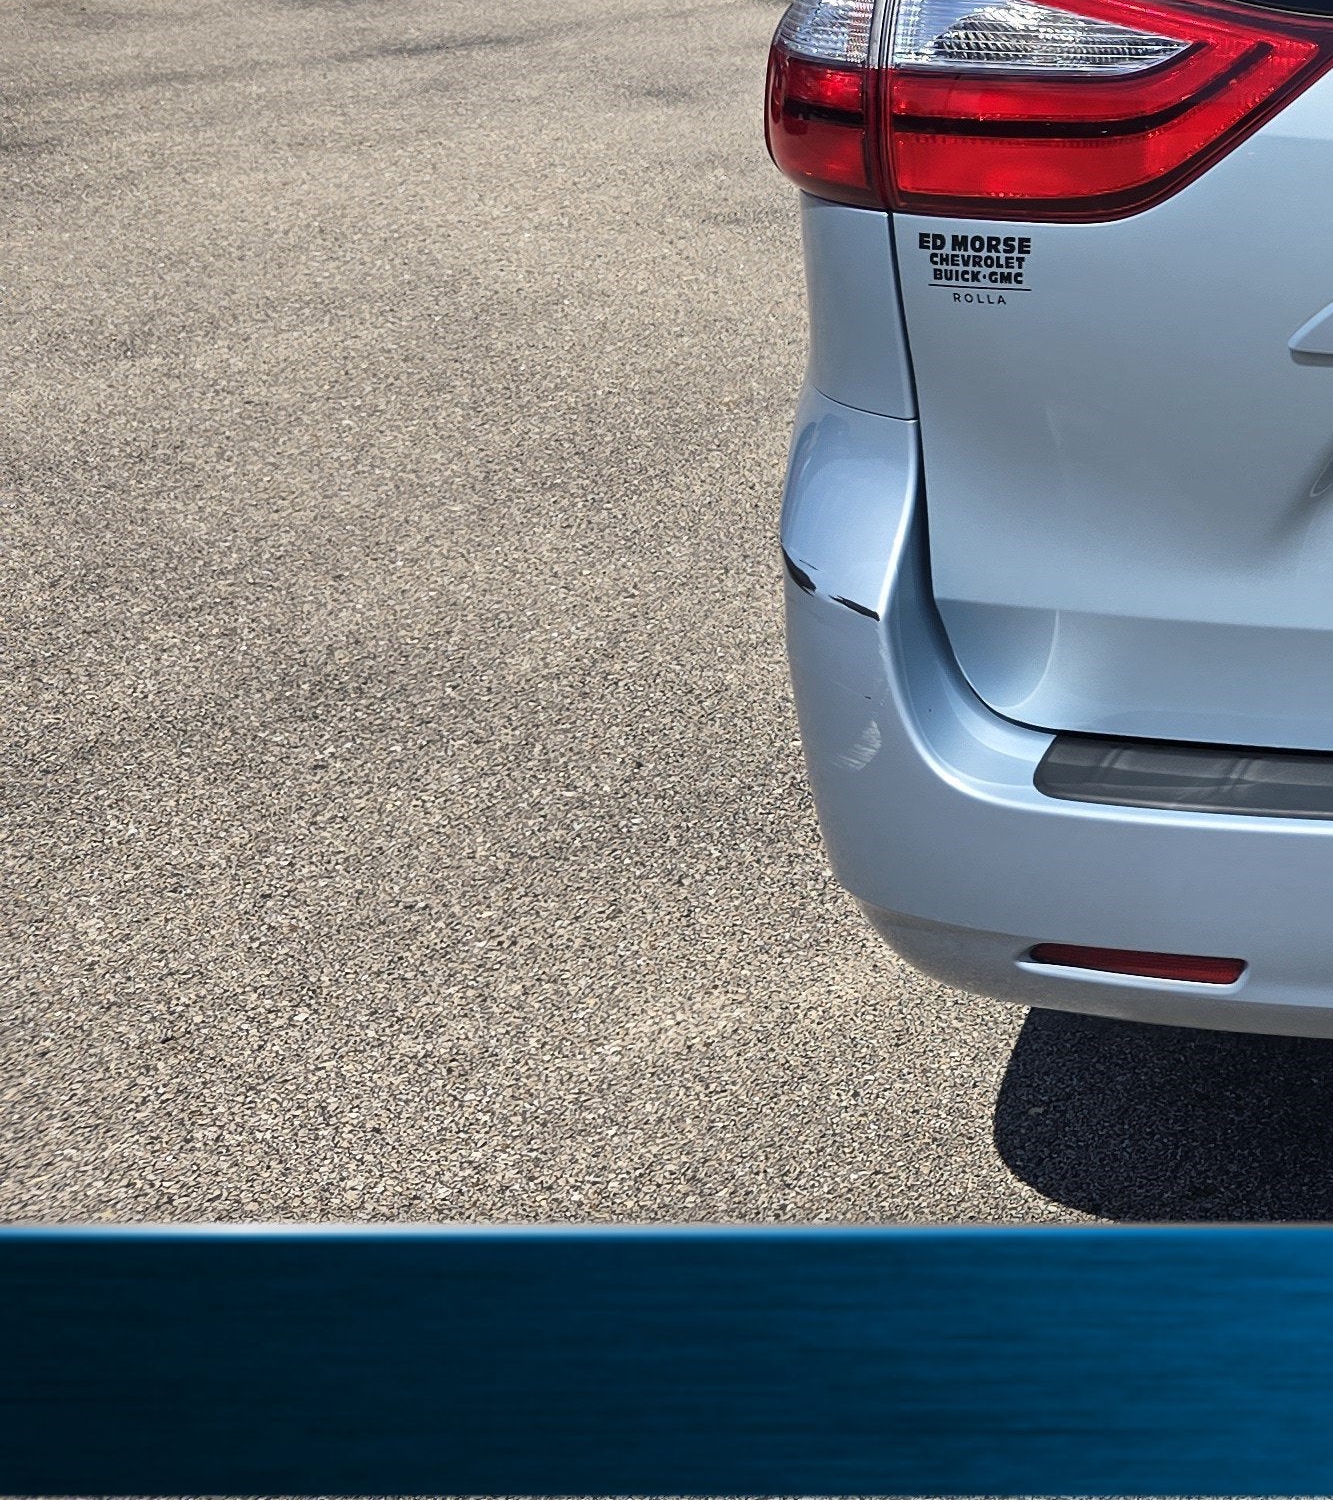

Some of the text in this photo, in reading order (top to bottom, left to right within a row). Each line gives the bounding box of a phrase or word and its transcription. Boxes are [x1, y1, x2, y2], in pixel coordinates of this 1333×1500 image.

[918, 232, 1032, 255] ED MORSE
[929, 253, 1026, 270] CHEVROLET
[953, 292, 1007, 306] ROLLA
